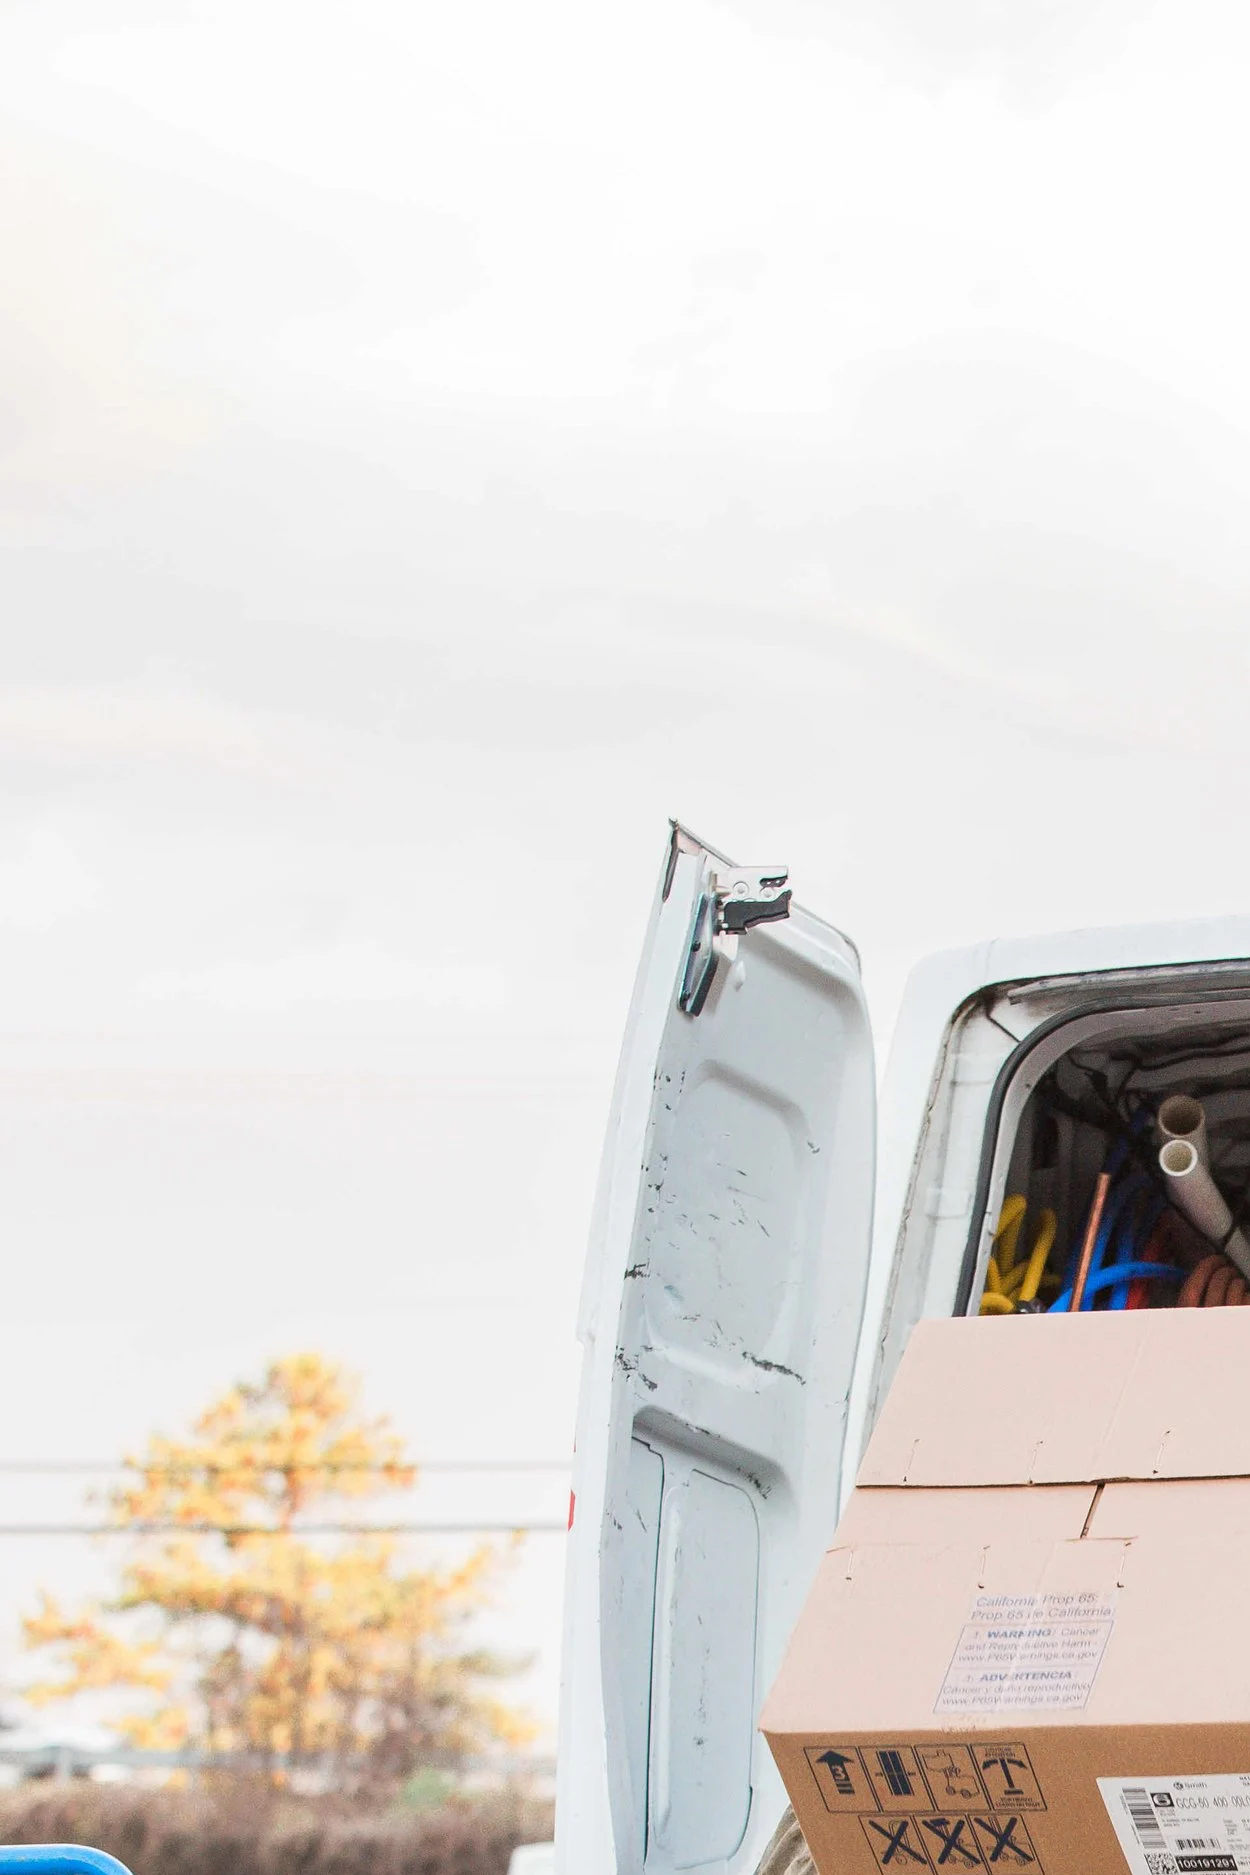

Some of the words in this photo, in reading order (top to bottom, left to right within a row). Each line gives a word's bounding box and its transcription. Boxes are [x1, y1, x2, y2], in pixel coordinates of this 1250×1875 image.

[1042, 1594, 1075, 1606] Prop
[971, 1609, 1003, 1622] Prop
[1006, 1609, 1024, 1620] 65
[1048, 1606, 1112, 1619] California
[1061, 1627, 1100, 1637] Cancer
[965, 1642, 987, 1652] and
[1061, 1640, 1091, 1650] Harm
[1213, 1796, 1229, 1809] 400
[1178, 1858, 1236, 1871] 100191291
